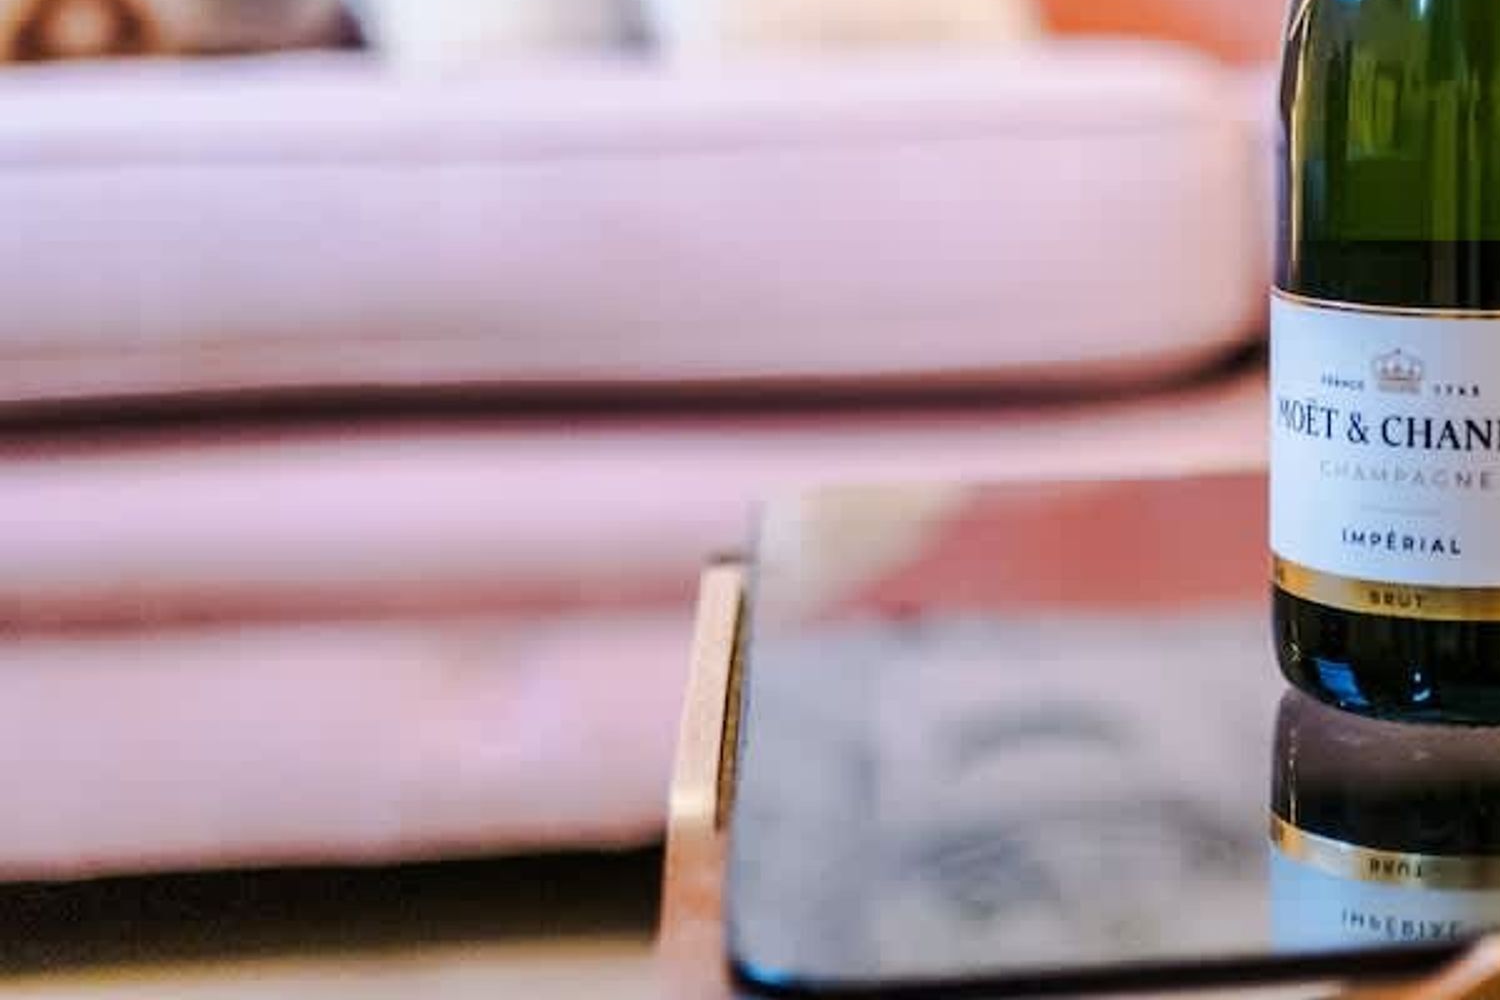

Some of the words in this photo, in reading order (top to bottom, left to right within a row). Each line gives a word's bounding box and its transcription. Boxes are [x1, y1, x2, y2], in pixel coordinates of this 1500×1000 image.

[1347, 411, 1370, 444] &
[1319, 460, 1496, 491] CHAMPAGNE
[1342, 526, 1462, 555] IMPÉRIAL
[1368, 588, 1425, 609] BRUT
